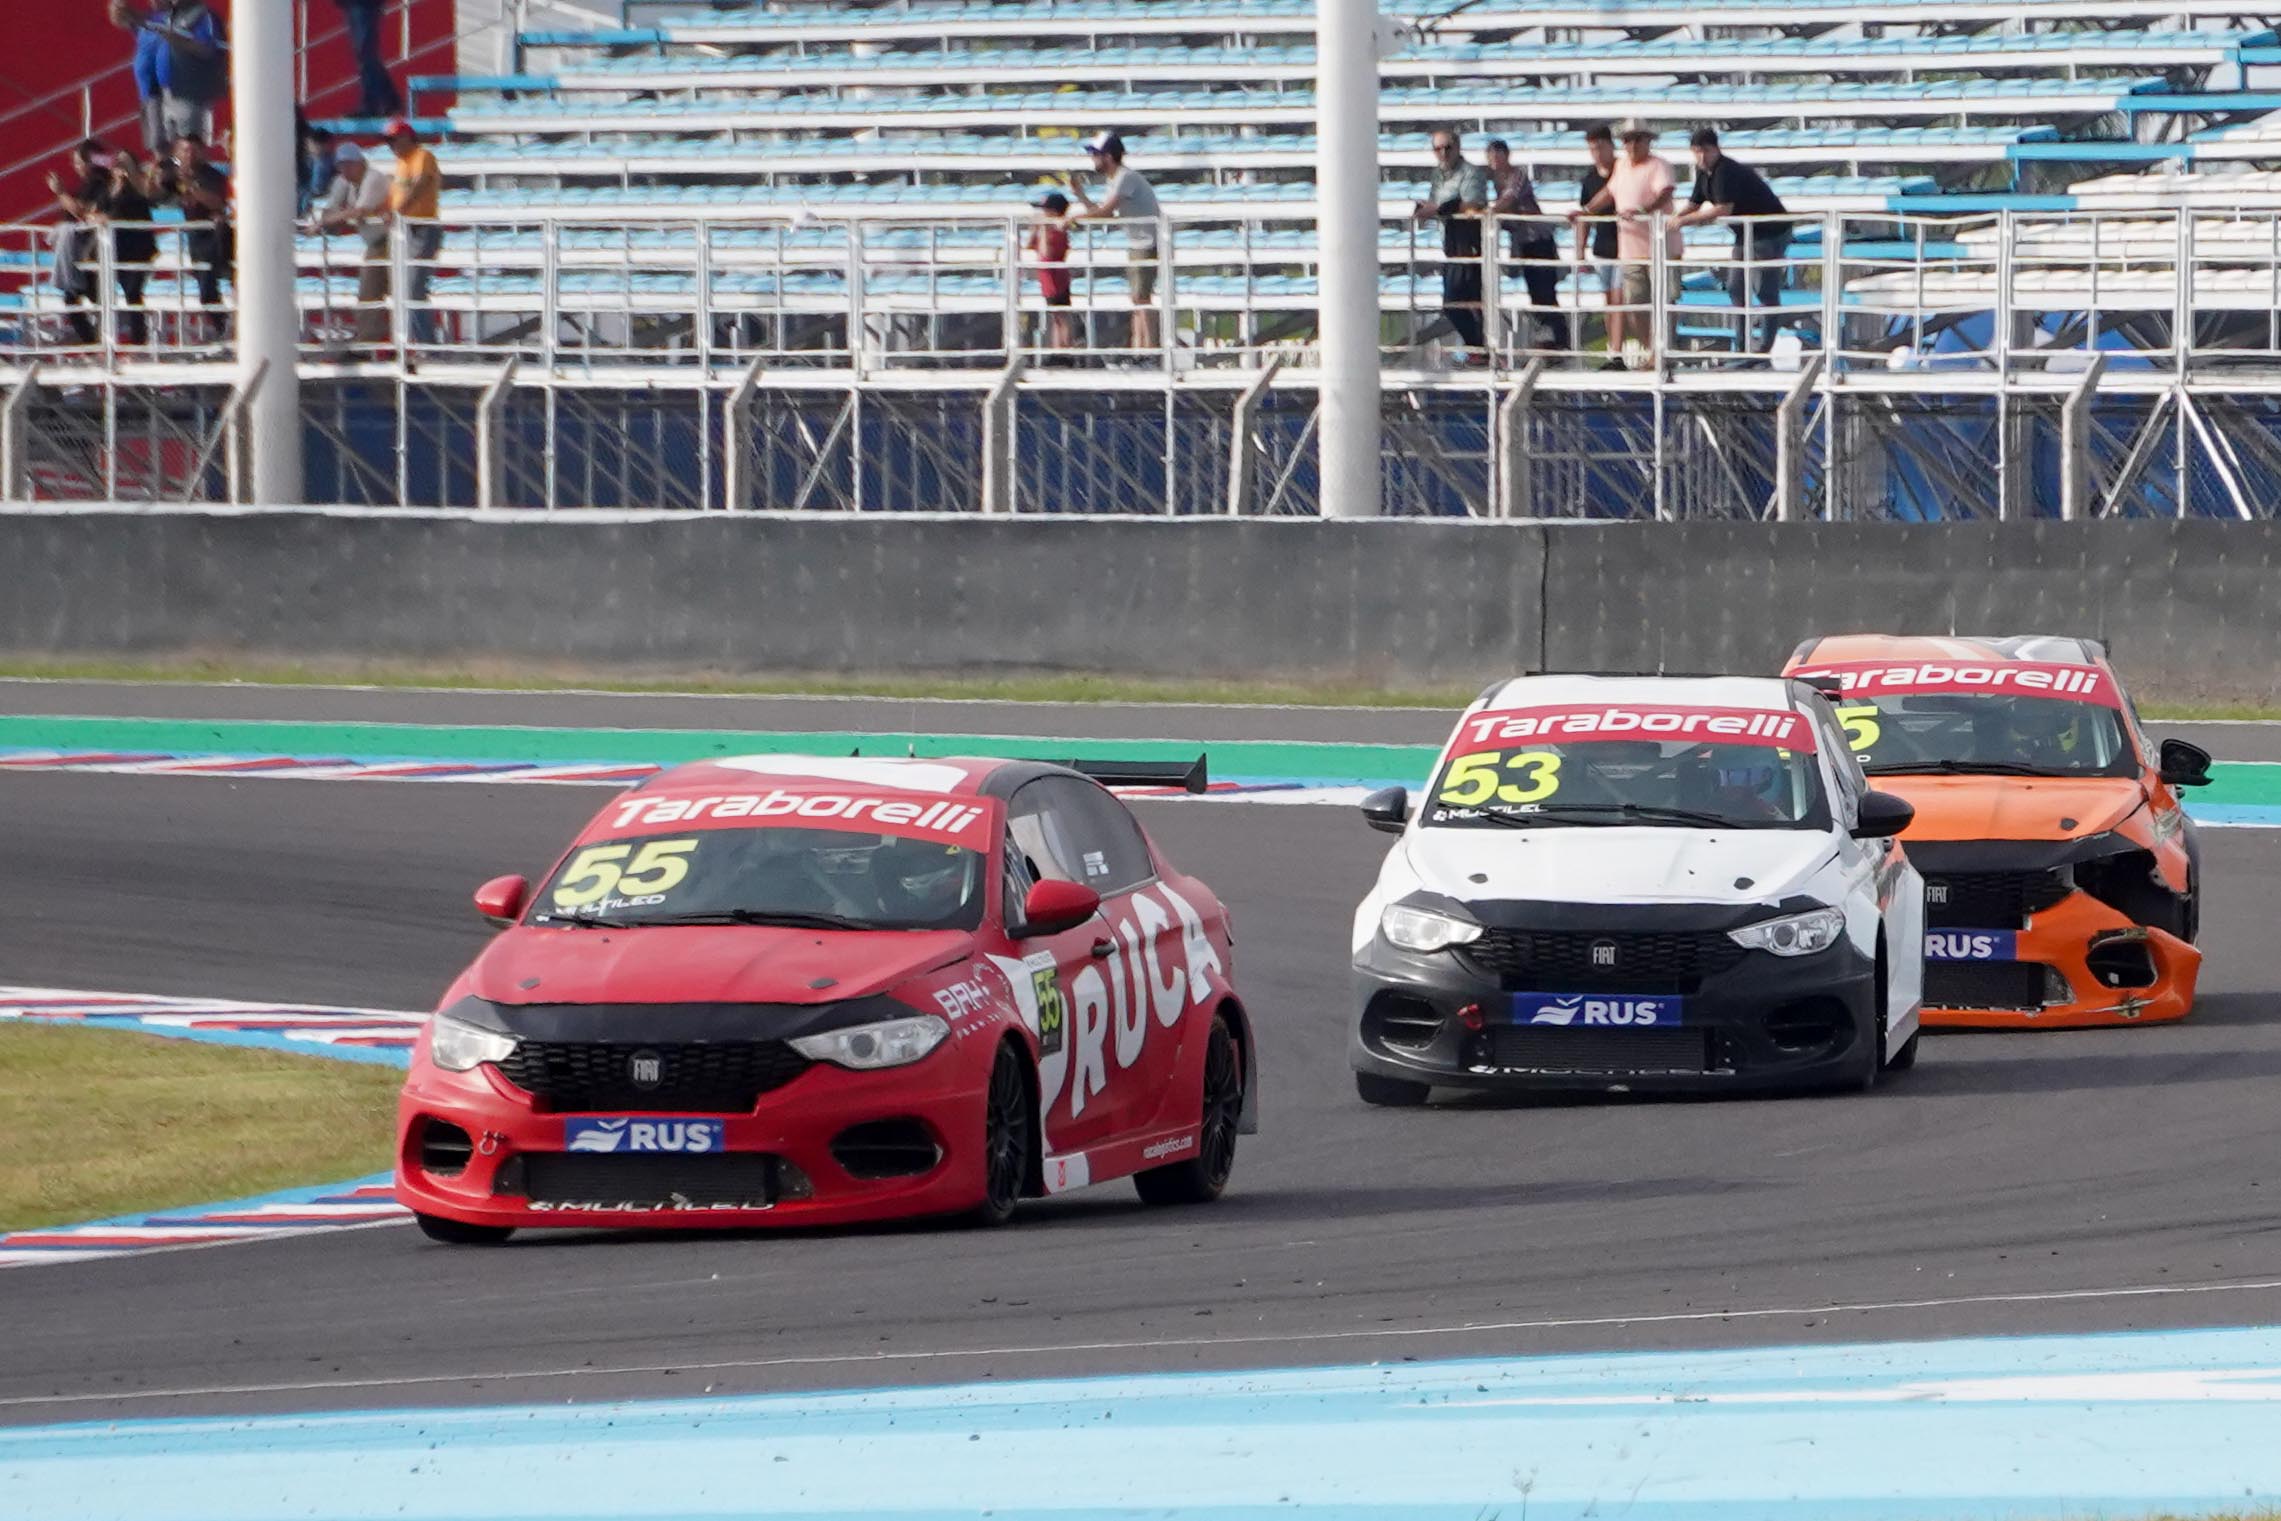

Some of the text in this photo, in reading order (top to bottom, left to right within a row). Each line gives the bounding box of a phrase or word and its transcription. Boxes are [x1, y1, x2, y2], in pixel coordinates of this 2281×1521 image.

[1470, 709, 1796, 742] Taraborelli
[1439, 751, 1561, 806] 53
[613, 790, 983, 833] Taraborelli
[553, 839, 699, 907] 55
[1926, 886, 1948, 903] FIAT
[1592, 946, 1616, 966] FIAT
[1925, 934, 1993, 959] RUS
[1032, 968, 1061, 1033] 55
[1584, 1000, 1657, 1026] RUS
[633, 1058, 659, 1082] FIAT
[629, 1122, 713, 1153] RUS
